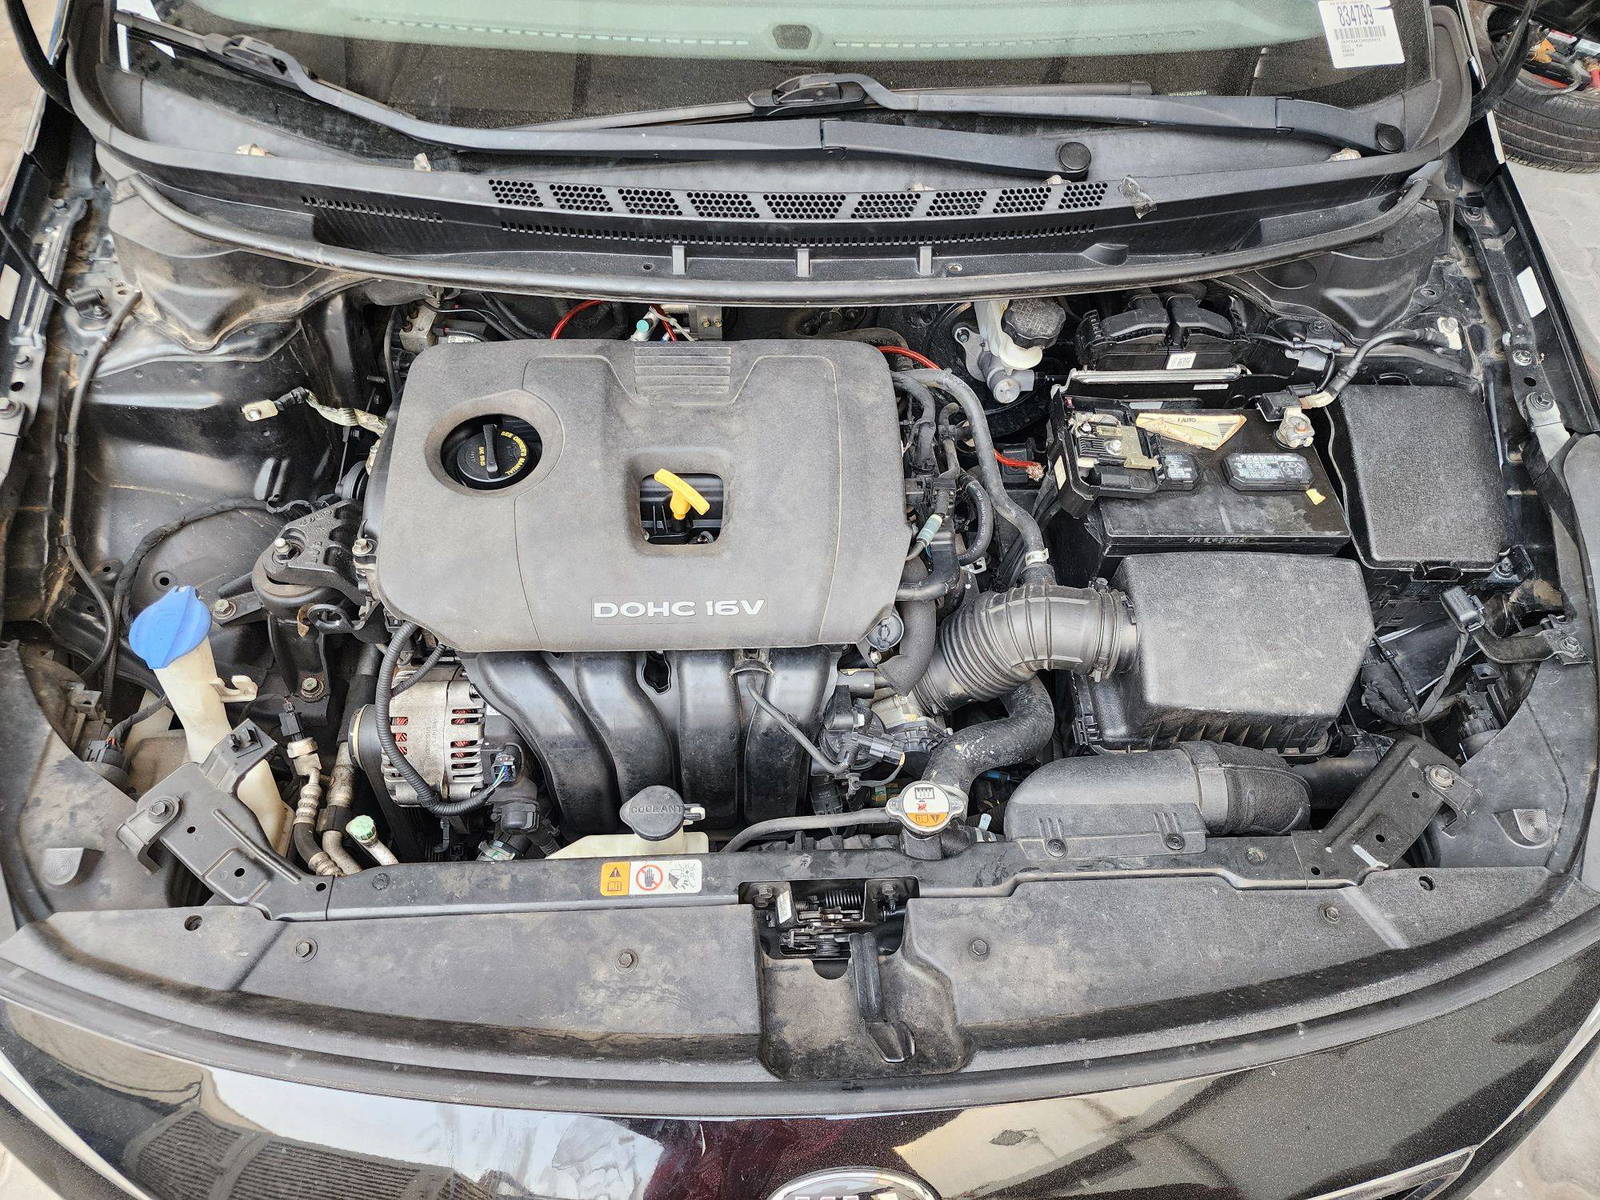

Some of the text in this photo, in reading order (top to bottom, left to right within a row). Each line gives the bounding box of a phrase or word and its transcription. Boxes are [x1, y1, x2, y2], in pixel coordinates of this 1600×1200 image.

[1337, 4, 1375, 26] 834799
[594, 599, 765, 617] DOHC 16V
[631, 804, 683, 814] COOLANT
